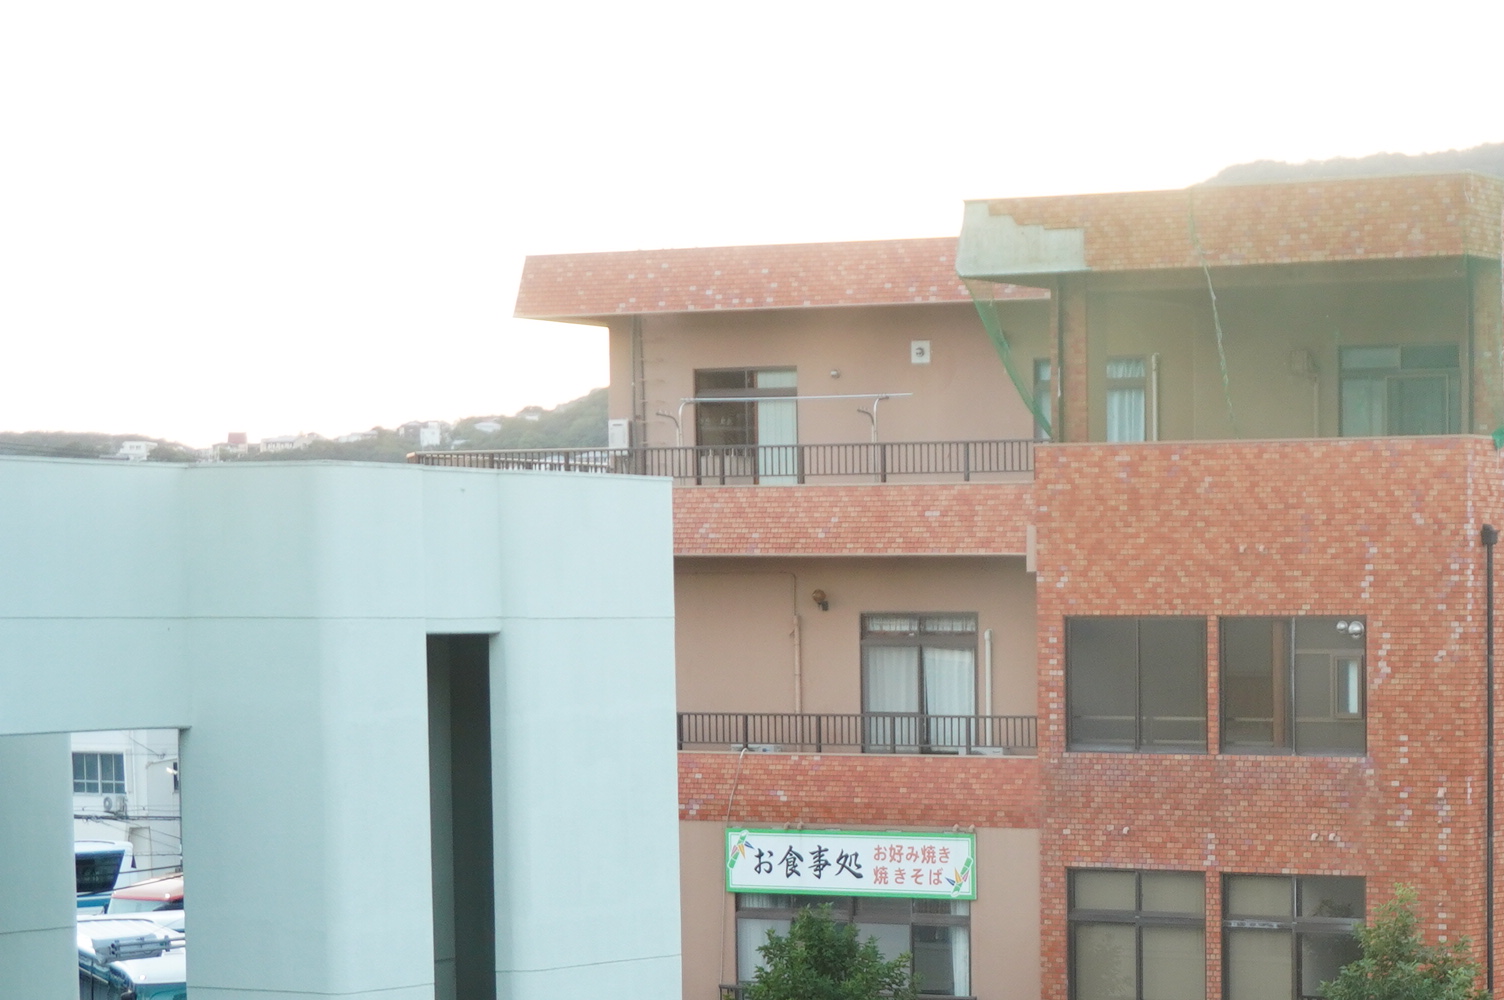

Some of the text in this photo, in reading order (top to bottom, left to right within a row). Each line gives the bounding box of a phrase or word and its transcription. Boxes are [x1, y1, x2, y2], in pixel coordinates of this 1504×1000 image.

[753, 844, 864, 880] お食事処
[873, 844, 951, 865] お好み焼き
[873, 866, 943, 886] 焼きそば
